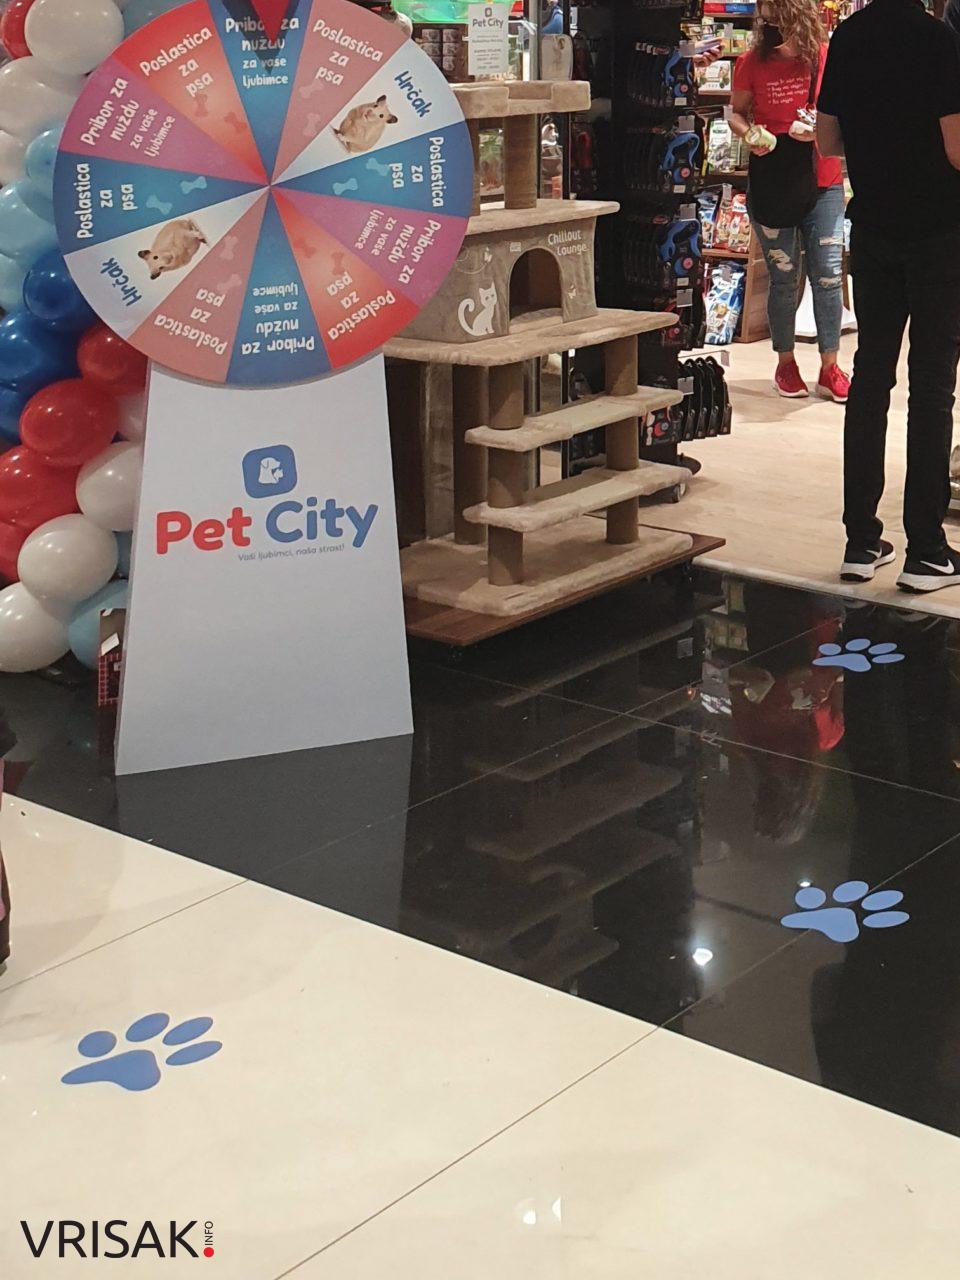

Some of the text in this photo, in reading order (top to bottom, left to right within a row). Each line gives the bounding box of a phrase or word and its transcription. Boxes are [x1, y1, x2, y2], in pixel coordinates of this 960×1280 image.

[225, 17, 300, 33] Pribo za
[472, 18, 504, 29] Pet City
[139, 27, 212, 76] Poslastica
[312, 19, 383, 62] Poslastica
[178, 58, 199, 77] za
[243, 59, 257, 69] za
[329, 51, 349, 67] za
[185, 72, 214, 97] psa
[243, 74, 289, 89] ljubimce
[315, 66, 344, 86] psa
[394, 71, 432, 117] Hrčak
[80, 78, 128, 146] Pribor za
[110, 99, 140, 141] nuždu
[130, 108, 158, 149] za vaše
[144, 115, 176, 157] ljubimce
[389, 163, 405, 188] psa
[411, 165, 424, 183] za
[428, 137, 447, 207] Poslastica
[73, 163, 94, 239] Poslastica
[100, 189, 113, 208] za
[121, 183, 138, 211] psa
[355, 209, 384, 249] ljubimce
[371, 216, 397, 256] za vaše
[547, 229, 582, 246] Chillout
[388, 224, 415, 263] nuždu
[398, 219, 441, 284] Pribor za
[557, 243, 588, 256] Lounge
[100, 257, 142, 307] Hrčak
[252, 282, 298, 297] ljubimce
[326, 271, 353, 296] psa
[196, 288, 226, 307] psa
[254, 301, 298, 315] za vaše
[340, 291, 360, 309] za
[190, 307, 212, 323] za
[328, 290, 396, 340] Poslastica
[154, 314, 228, 355] Poslastica
[256, 318, 299, 338] nuždu
[241, 336, 315, 355] Pribor za
[156, 496, 378, 555] Pet City
[296, 546, 317, 556] naša
